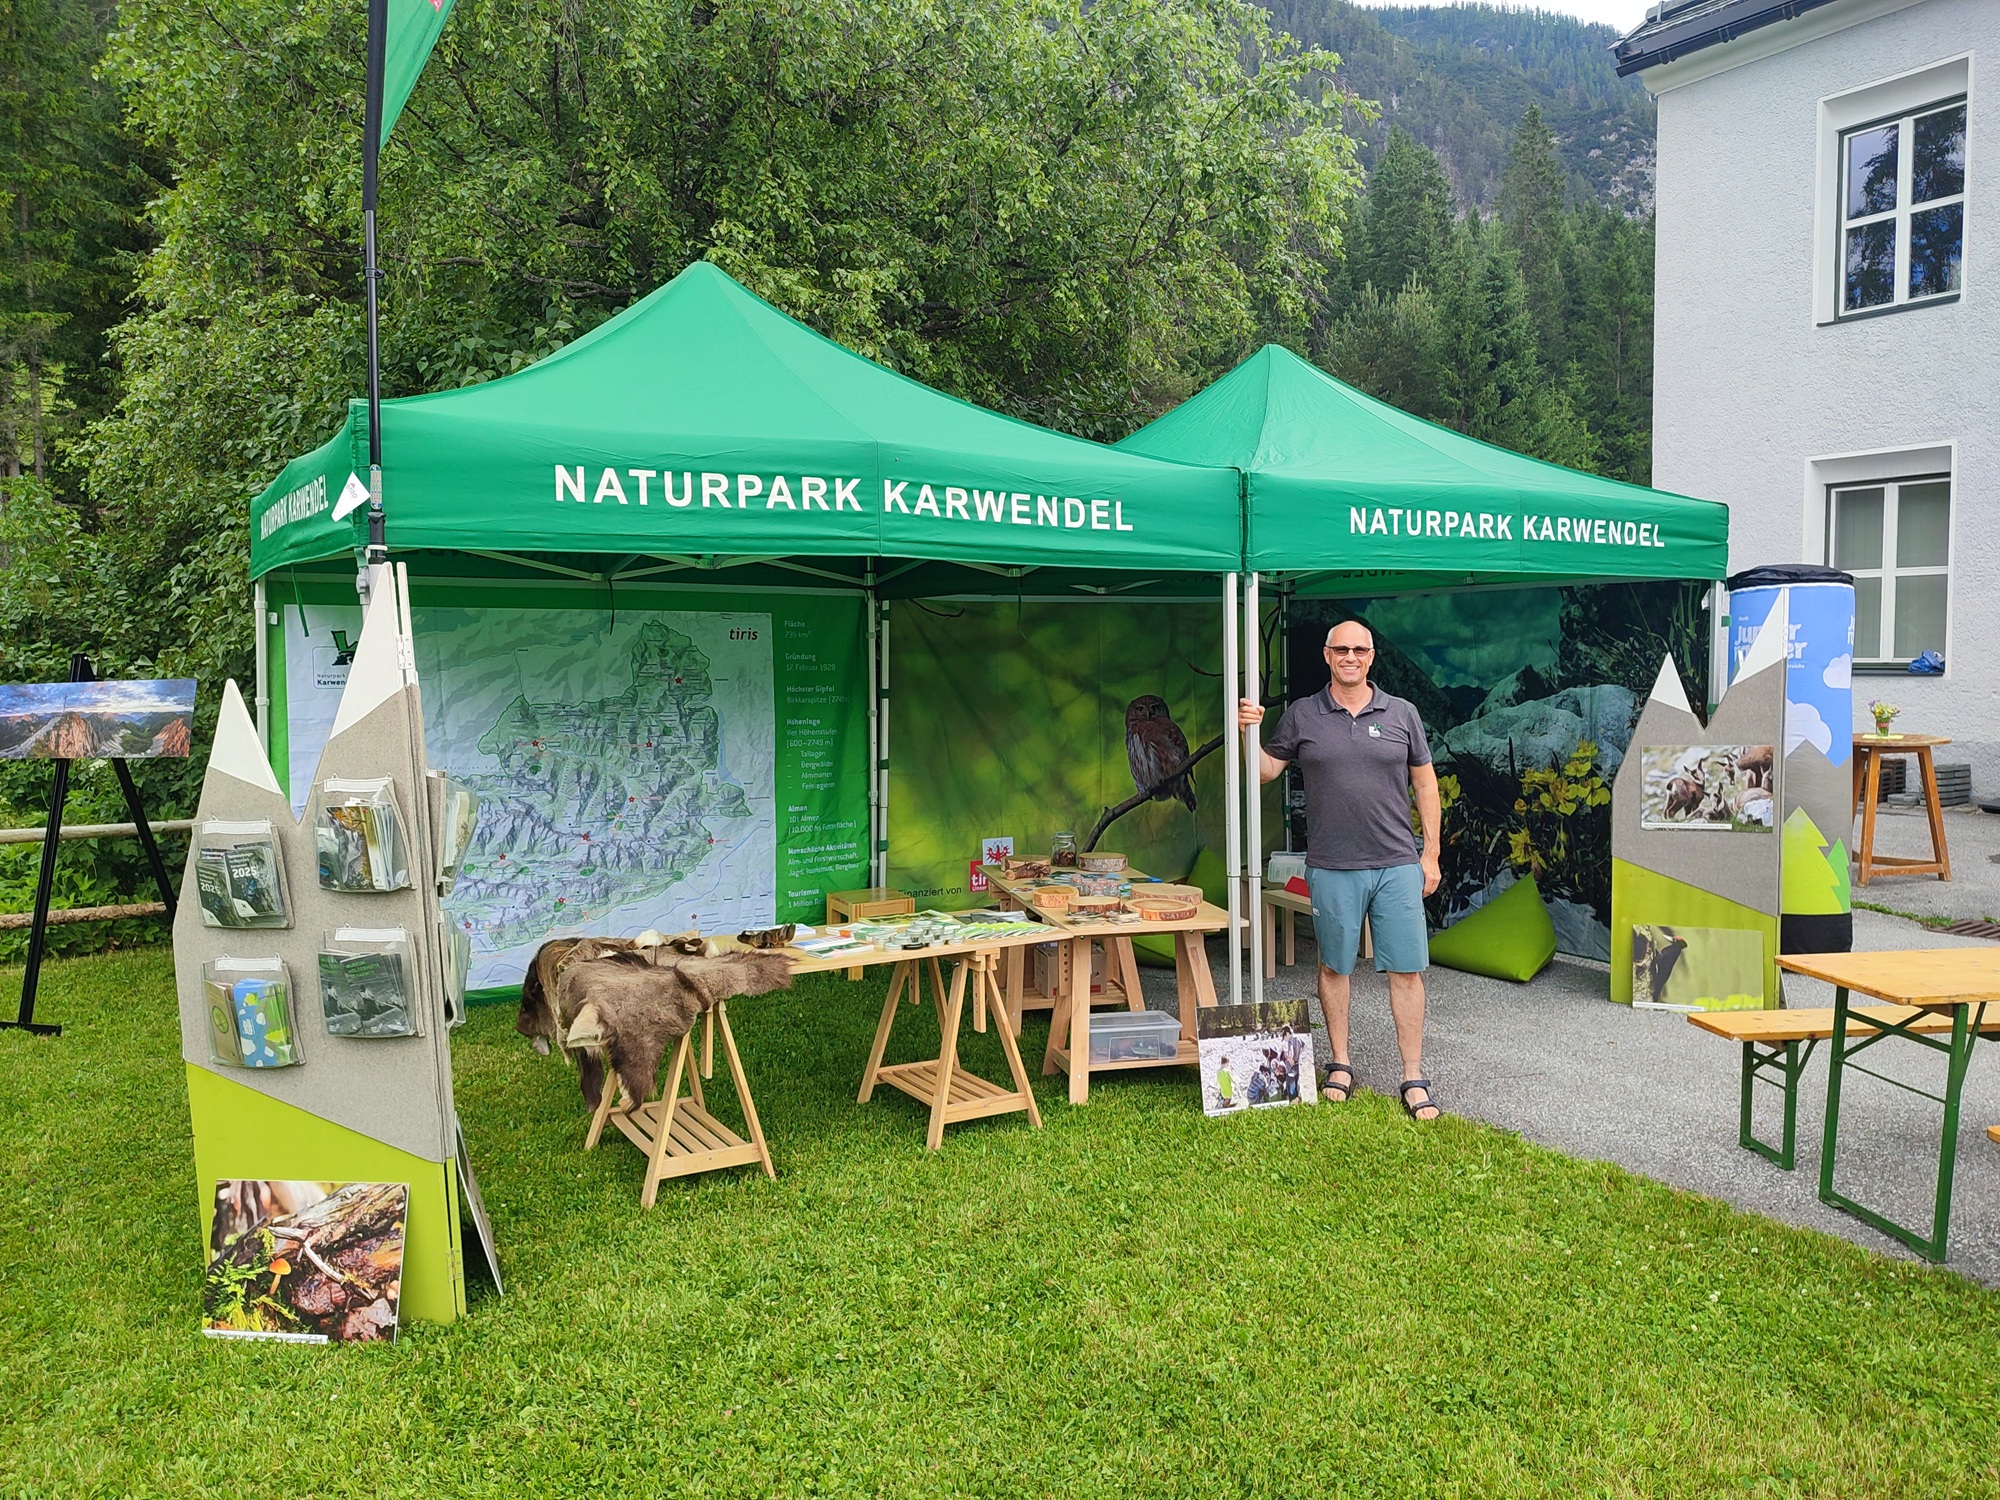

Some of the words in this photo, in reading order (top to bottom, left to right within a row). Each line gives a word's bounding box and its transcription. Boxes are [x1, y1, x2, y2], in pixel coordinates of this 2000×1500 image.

[554, 464, 863, 512] NATURPARK
[884, 479, 1134, 531] KARWENDEL
[260, 494, 288, 542] NATURPARK
[288, 474, 329, 523] KARWENDEL
[1350, 507, 1514, 540] NATURPARK
[1523, 515, 1665, 547] KARWENDEL
[784, 620, 806, 628] Fläche
[729, 627, 758, 641] tiris
[1734, 623, 1803, 646] junr
[785, 653, 816, 662] Gründung
[795, 663, 818, 671] Februar
[820, 663, 836, 671] 1928
[786, 685, 814, 693] Höchster
[815, 685, 835, 694] Gipfel
[786, 718, 821, 727] Höhenlage
[798, 728, 837, 737] Höhenstufen
[800, 750, 826, 759] Tallagen
[801, 760, 833, 770] Bergwälder
[787, 805, 808, 813] Almen
[800, 814, 819, 822] Almen
[787, 845, 825, 855] Menschliche
[825, 841, 857, 851] Aktivitäten
[802, 856, 814, 864] und
[232, 866, 258, 879] 2025
[971, 873, 987, 886] tir
[200, 882, 221, 895] 2025
[787, 888, 820, 898] Tourismus
[898, 887, 944, 898] inanziert
[945, 886, 962, 895] von
[793, 899, 814, 908] Million
